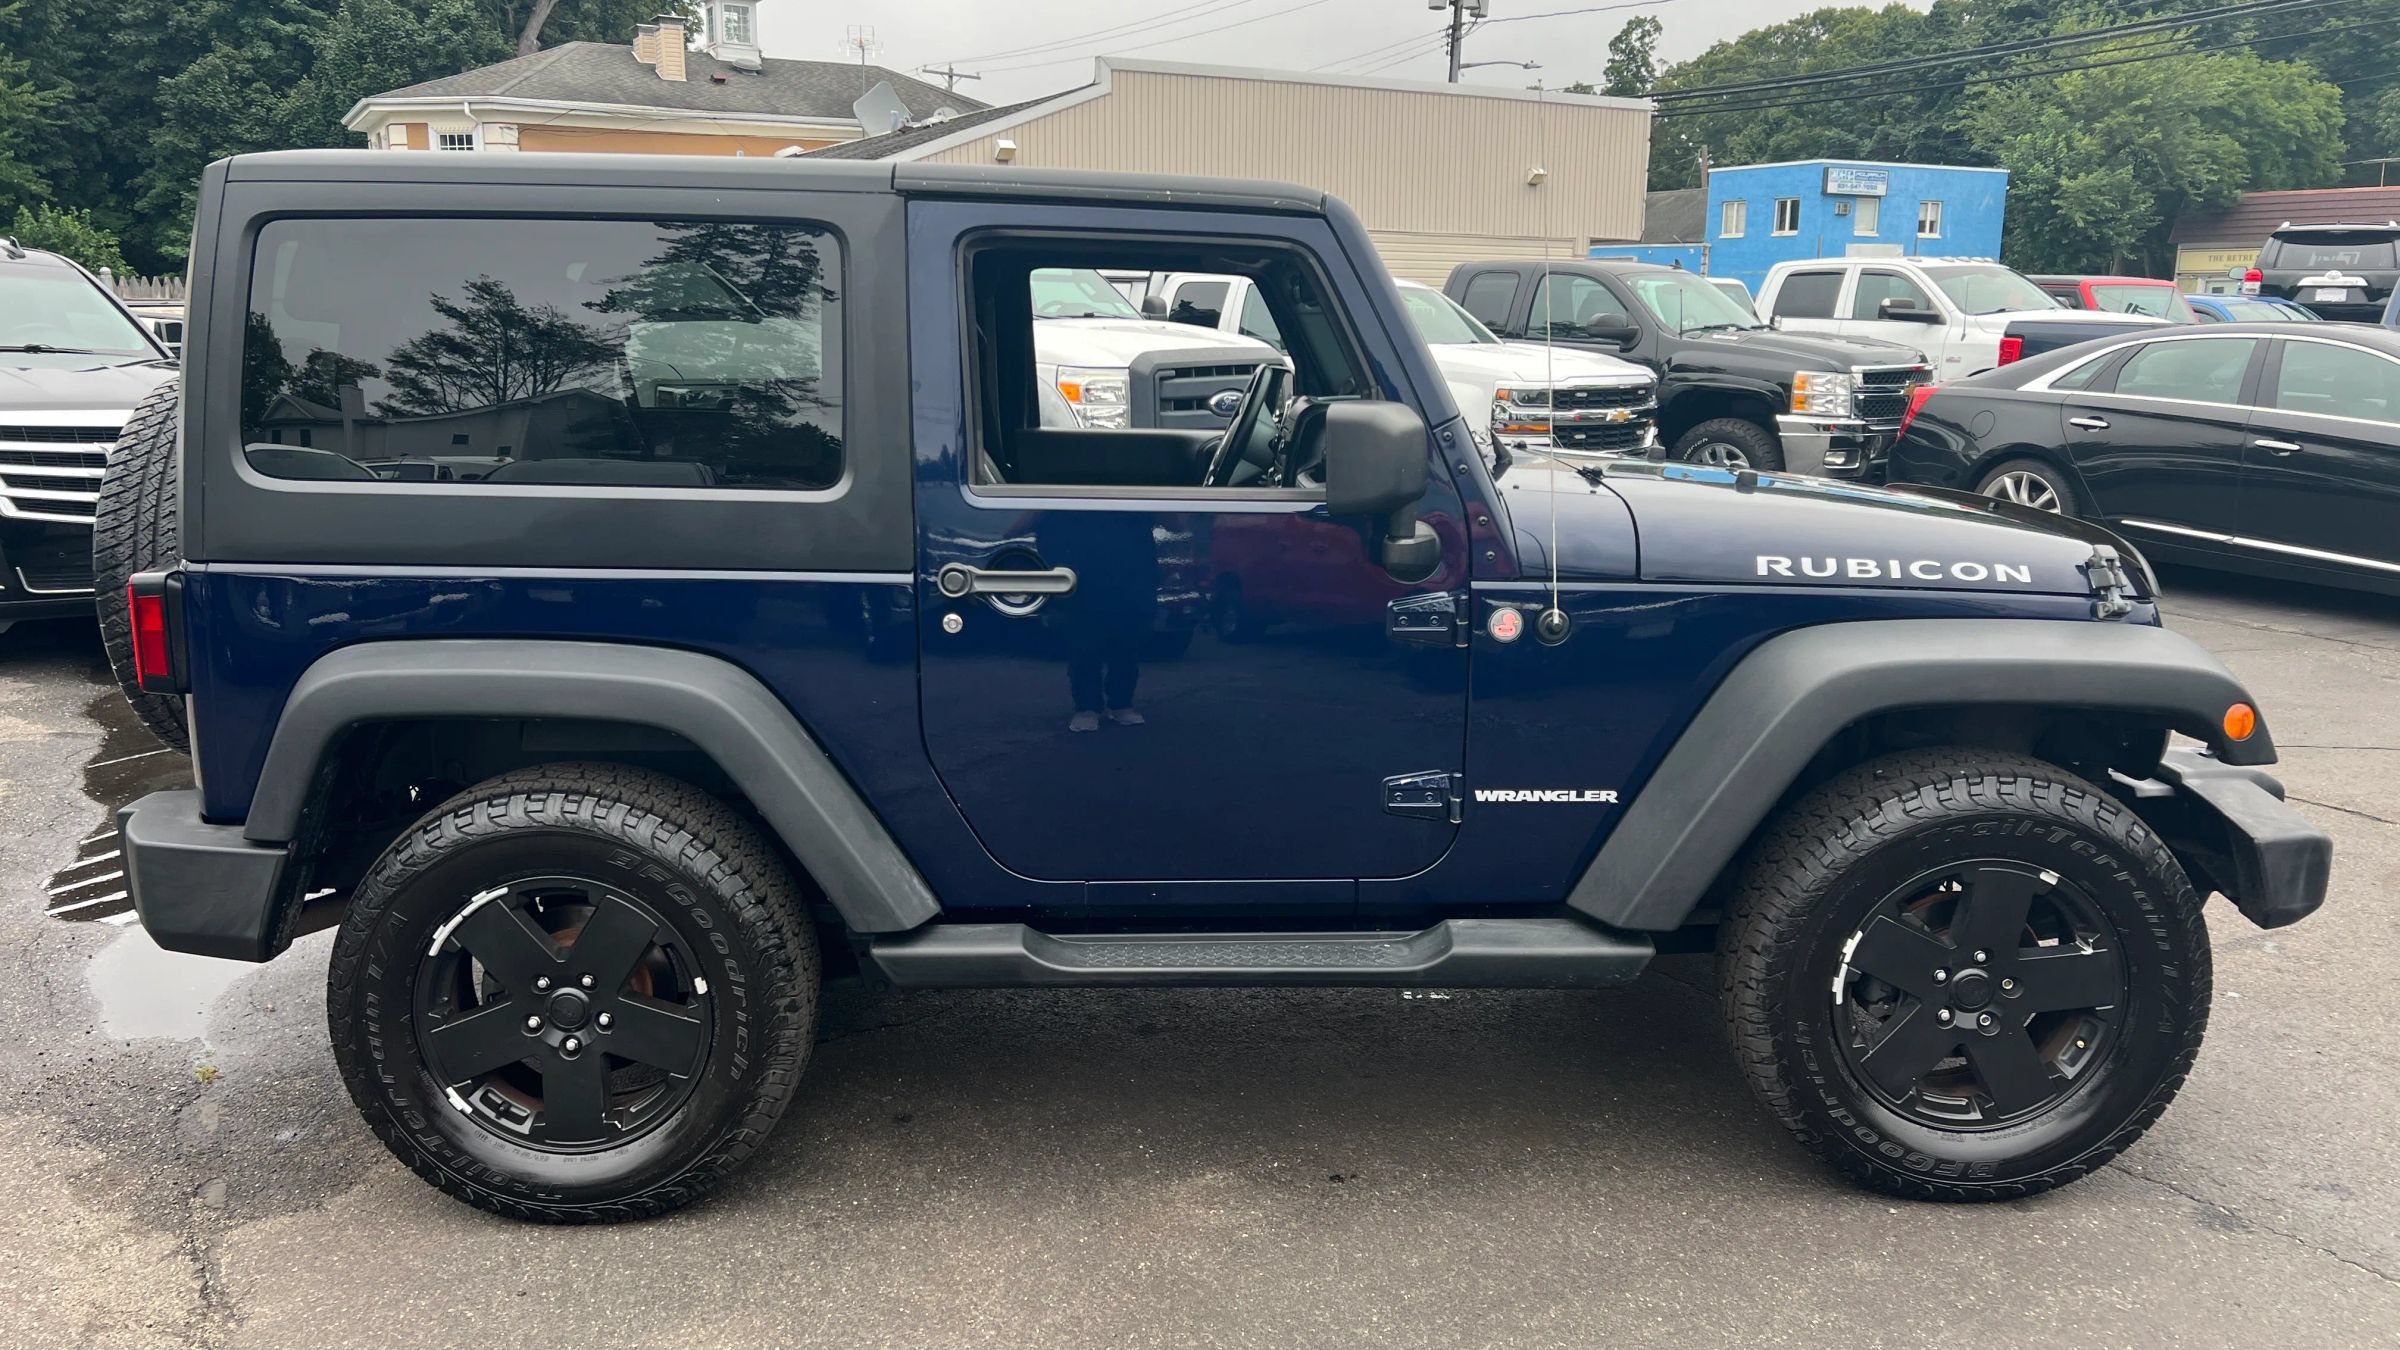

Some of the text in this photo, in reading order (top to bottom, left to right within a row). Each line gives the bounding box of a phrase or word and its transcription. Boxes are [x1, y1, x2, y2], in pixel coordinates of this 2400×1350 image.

[2226, 254, 2257, 262] RETRE
[1756, 555, 2032, 583] RUBICON
[1474, 790, 1619, 803] WRANGLER
[607, 849, 749, 1081] BFGoodrich
[1796, 1020, 2000, 1178] BFGoodrich
